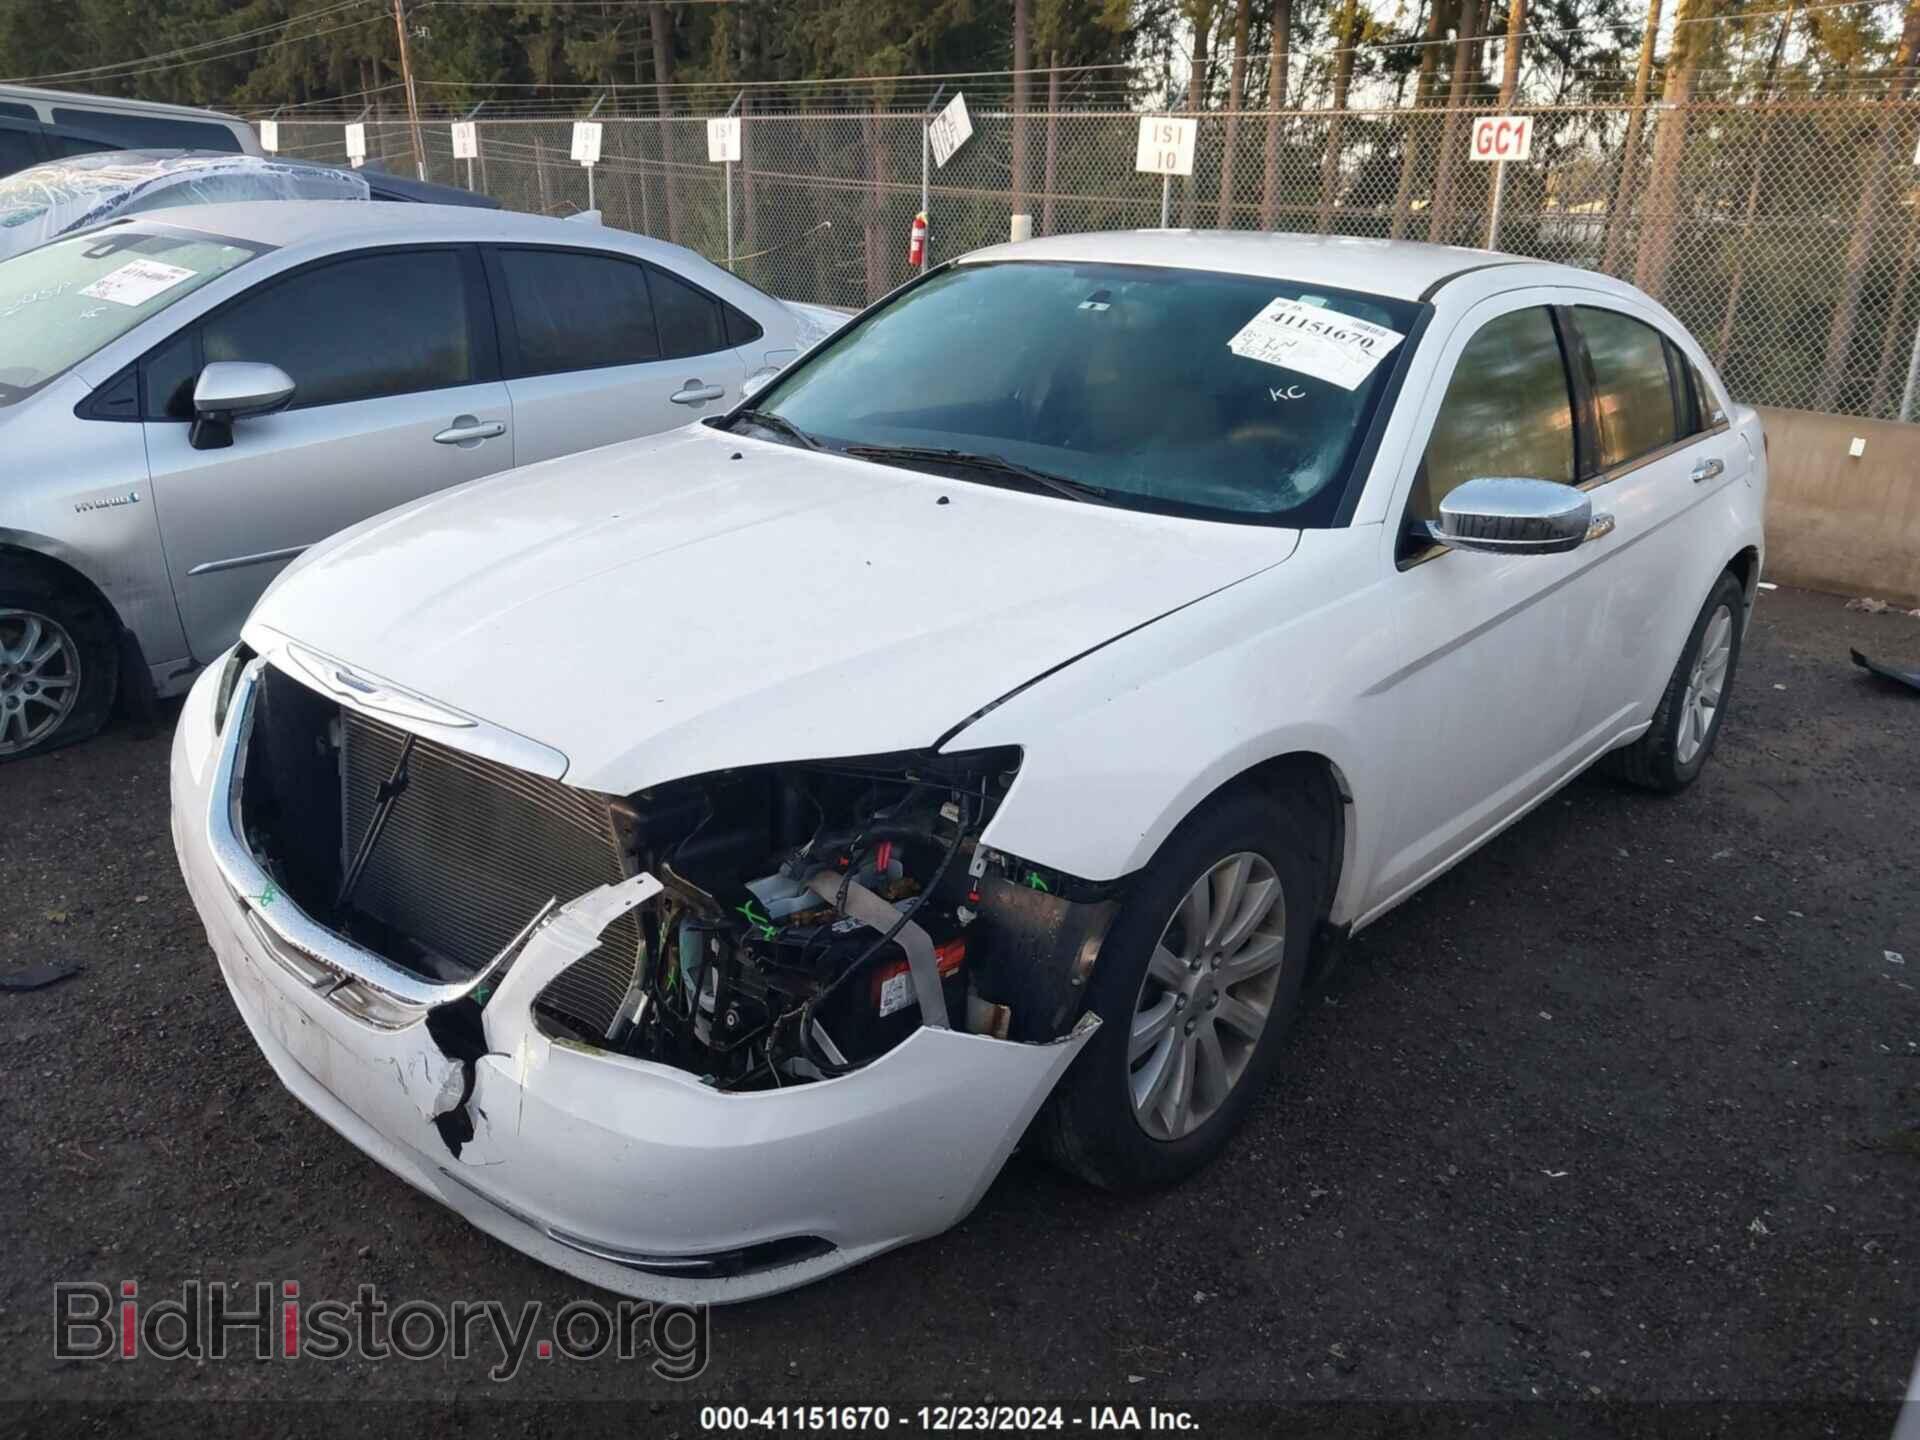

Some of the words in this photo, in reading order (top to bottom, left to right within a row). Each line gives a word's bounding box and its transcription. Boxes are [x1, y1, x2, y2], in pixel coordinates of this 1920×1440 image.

[1477, 121, 1525, 155] GC1
[1269, 311, 1376, 350] 41151670
[1269, 384, 1306, 402] KC
